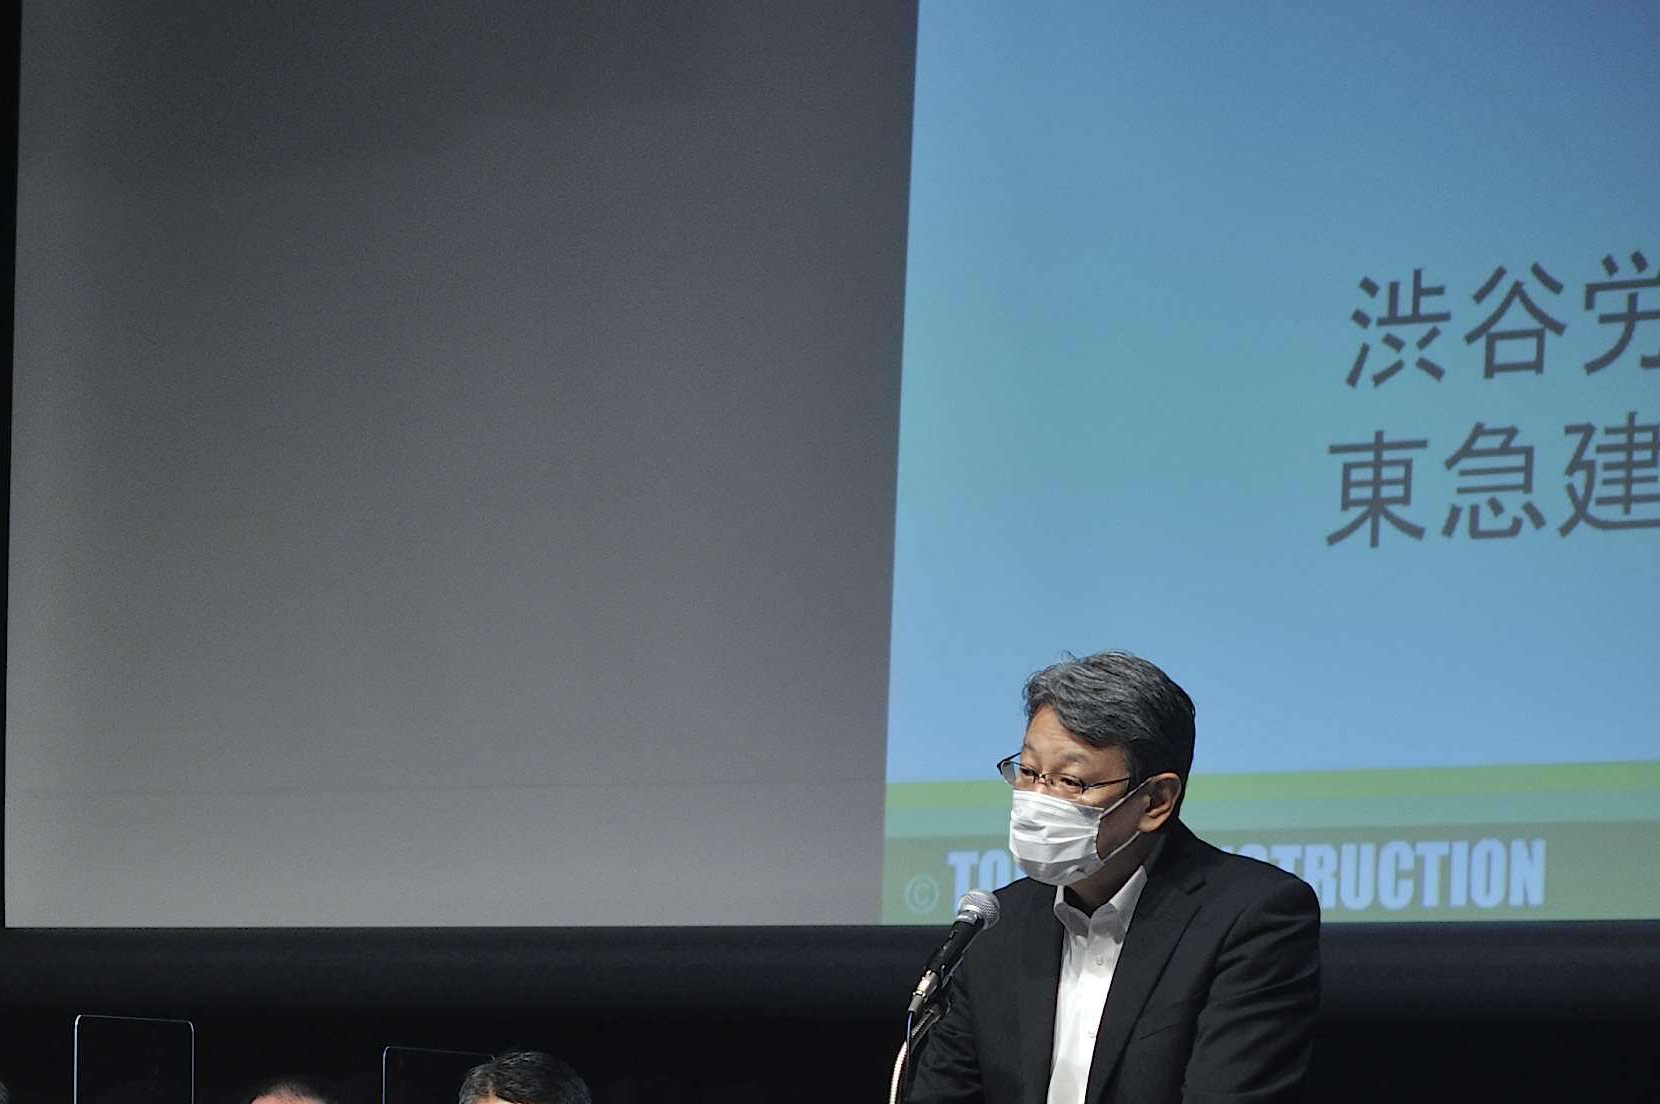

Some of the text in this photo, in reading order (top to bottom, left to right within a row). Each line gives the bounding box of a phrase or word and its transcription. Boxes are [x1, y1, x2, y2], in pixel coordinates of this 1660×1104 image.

[1345, 249, 1660, 389] 渋谷労
[1326, 411, 1660, 549] 東急建
